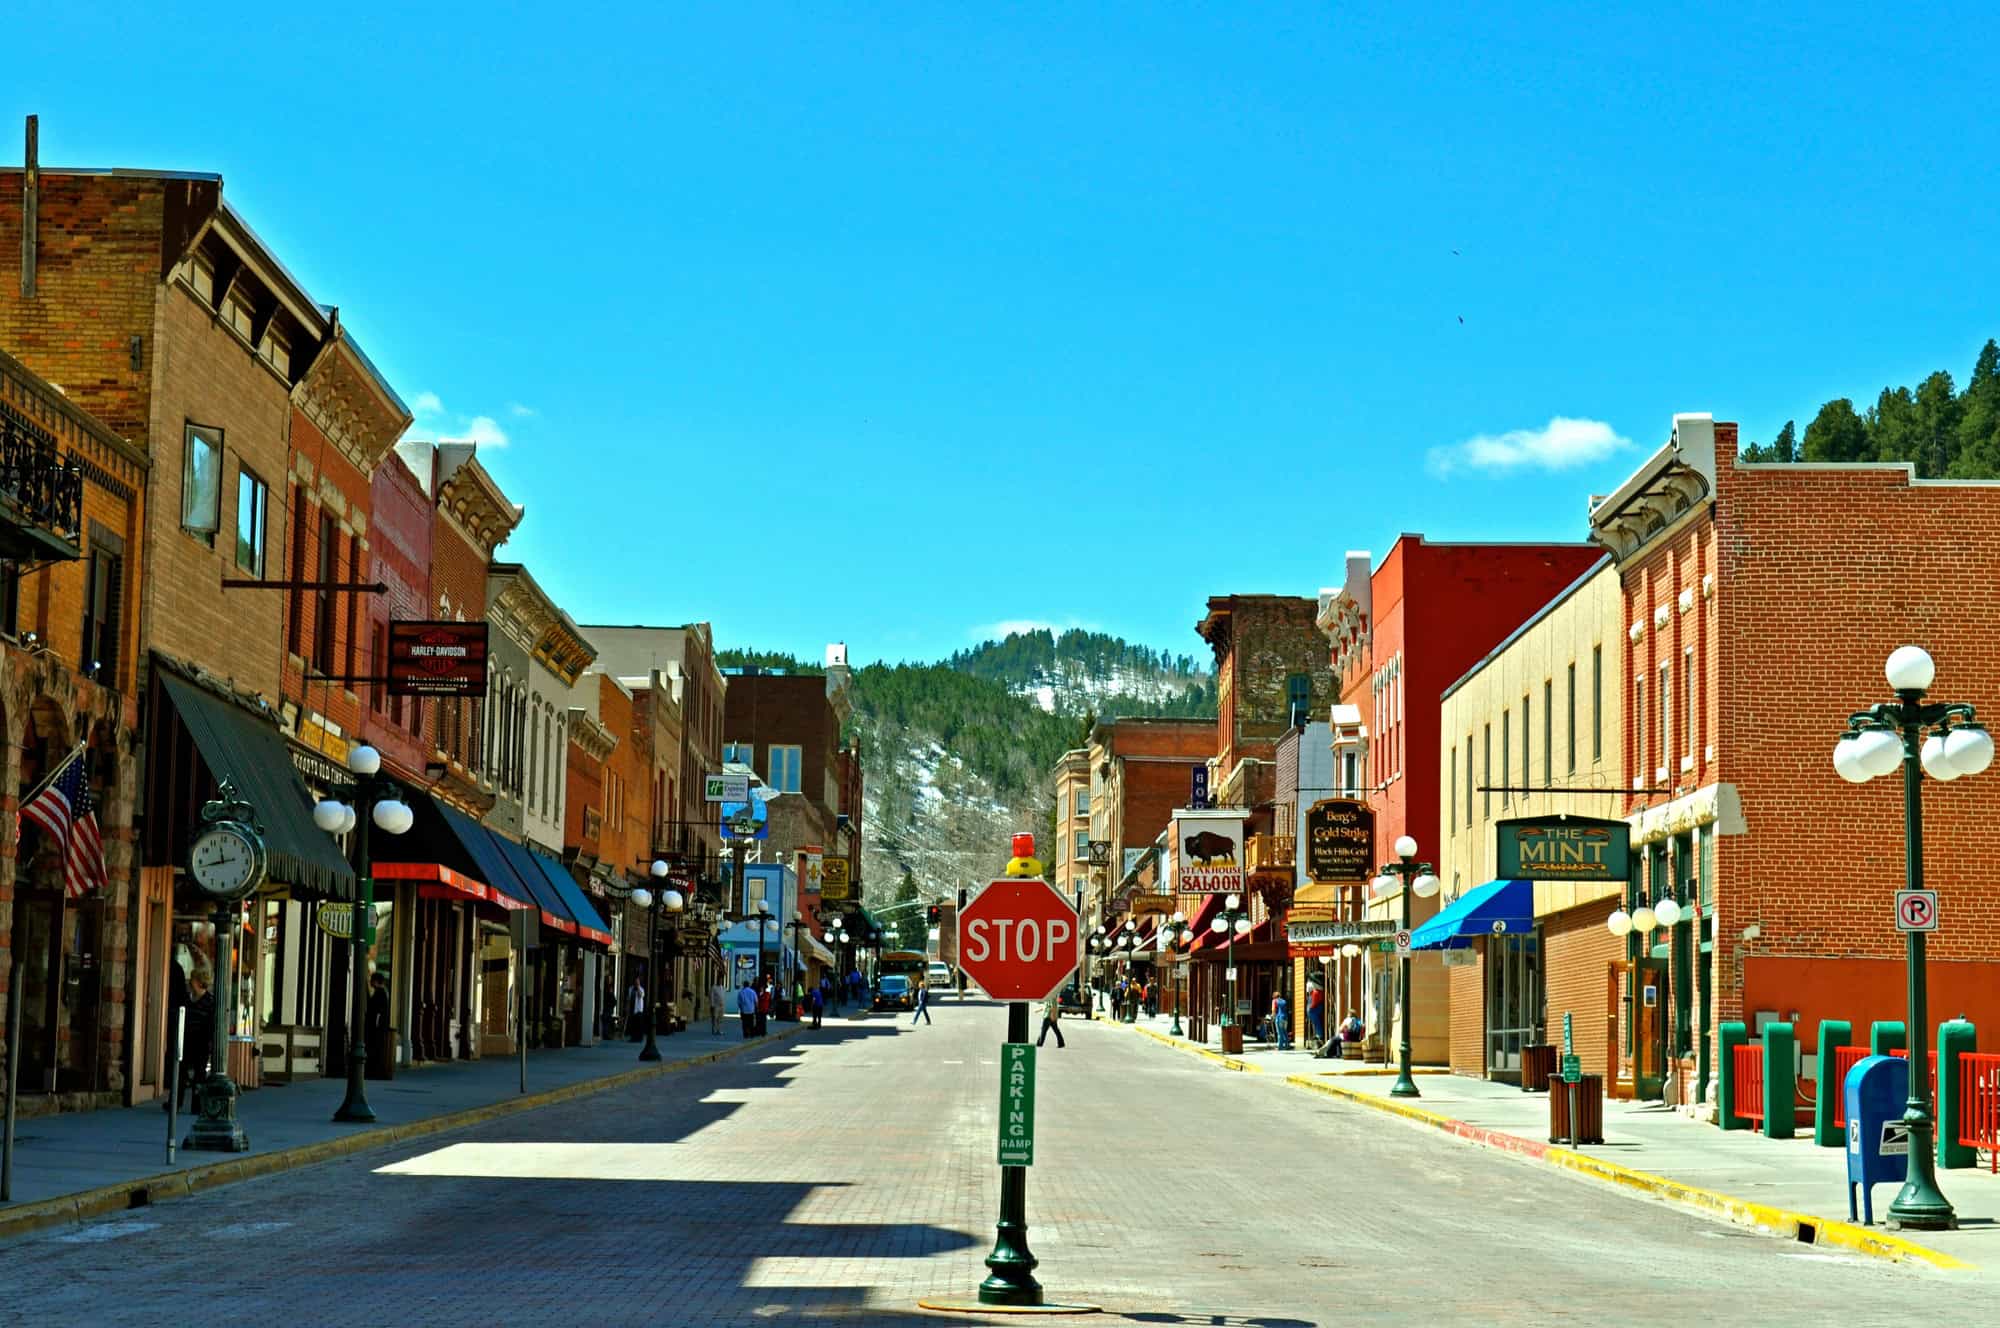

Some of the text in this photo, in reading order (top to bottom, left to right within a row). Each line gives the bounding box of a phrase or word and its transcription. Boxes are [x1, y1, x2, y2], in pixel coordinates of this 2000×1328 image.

[411, 646, 466, 656] HARLEY-DAVIDSON
[1327, 811, 1357, 824] Berg's
[1314, 827, 1368, 838] Gold Strike
[1544, 828, 1582, 839] THE
[1520, 841, 1609, 862] MINT
[1182, 876, 1240, 891] SALOON
[1294, 925, 1336, 939] FAMOUS
[967, 918, 1070, 962] STOP
[1009, 1047, 1025, 1136] PARKING
[1001, 1139, 1031, 1148] RAMP
